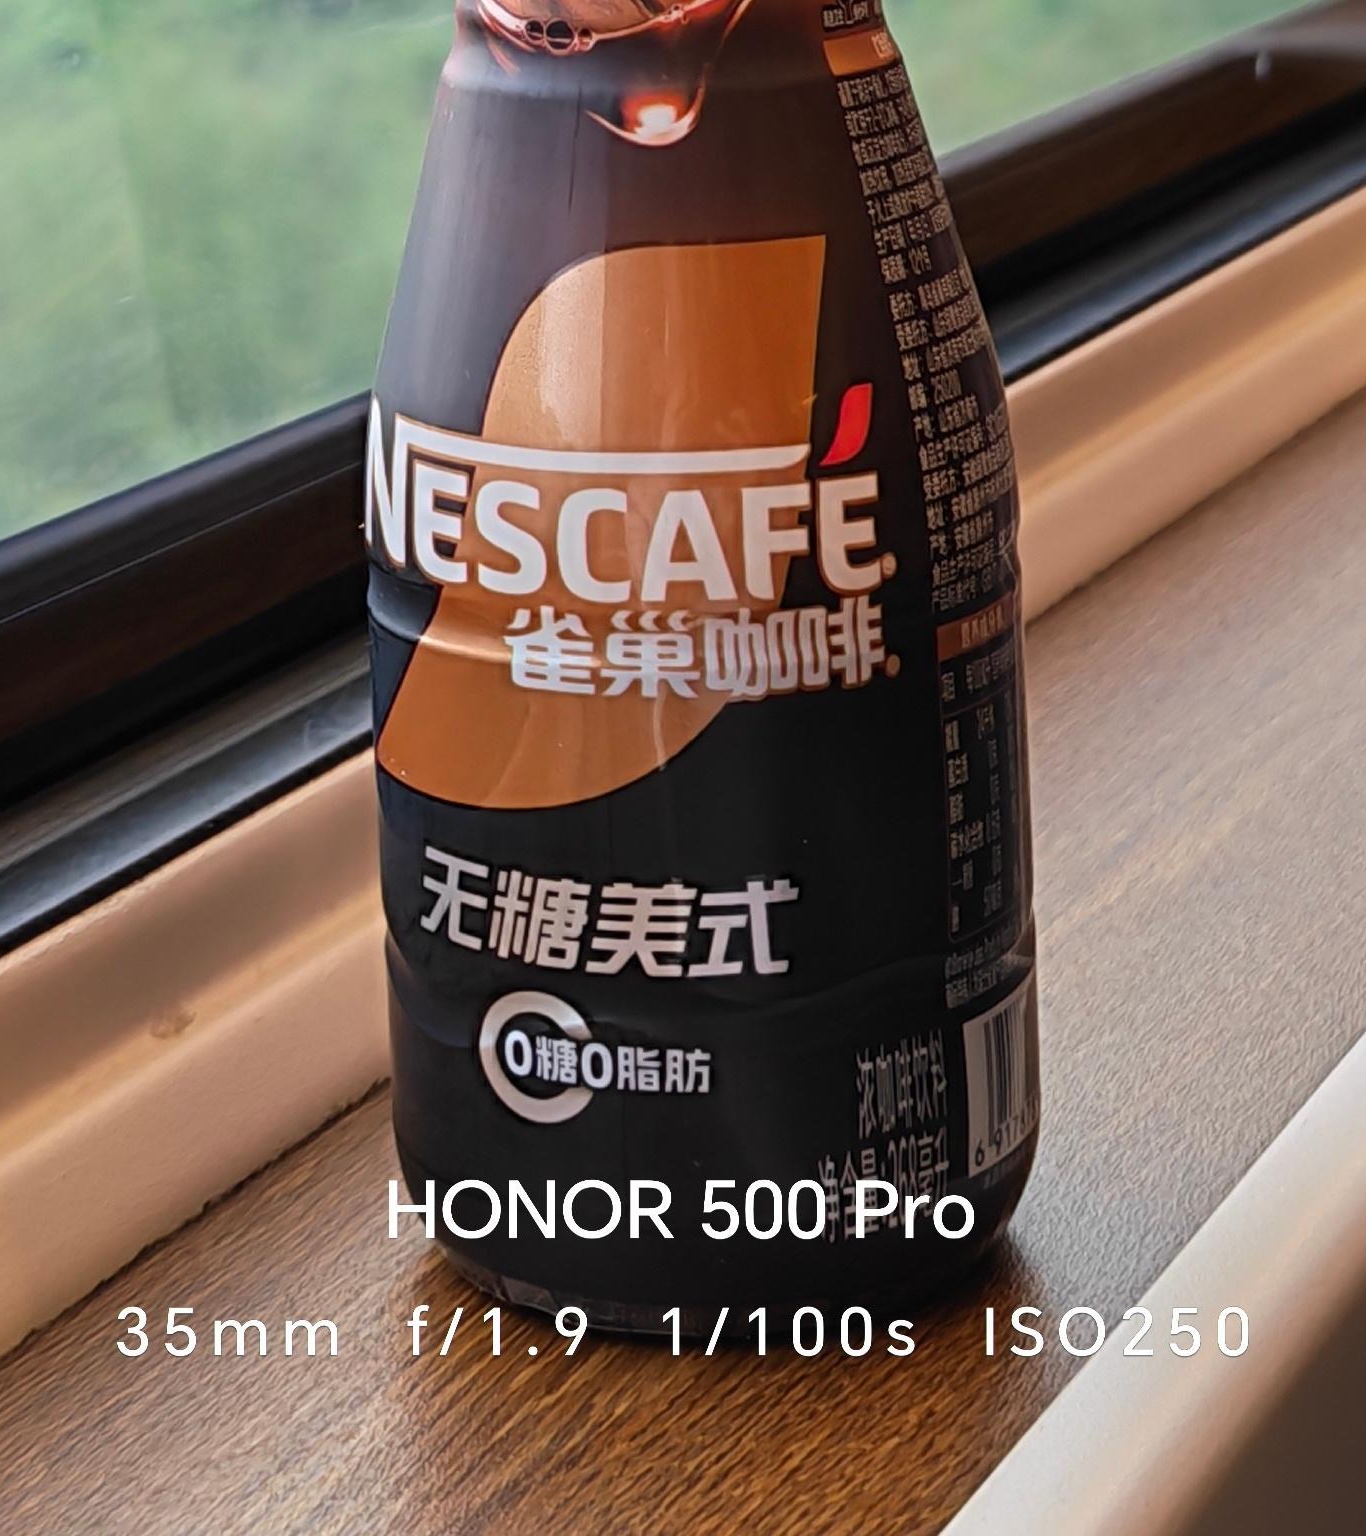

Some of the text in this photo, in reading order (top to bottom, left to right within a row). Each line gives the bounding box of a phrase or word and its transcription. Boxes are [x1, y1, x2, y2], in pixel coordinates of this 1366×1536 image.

[365, 383, 880, 604] NESCAFÉ
[503, 595, 887, 700] 雀巢咖啡
[419, 846, 800, 979] 无糖美式
[503, 1028, 712, 1094] 0糖0脂肪
